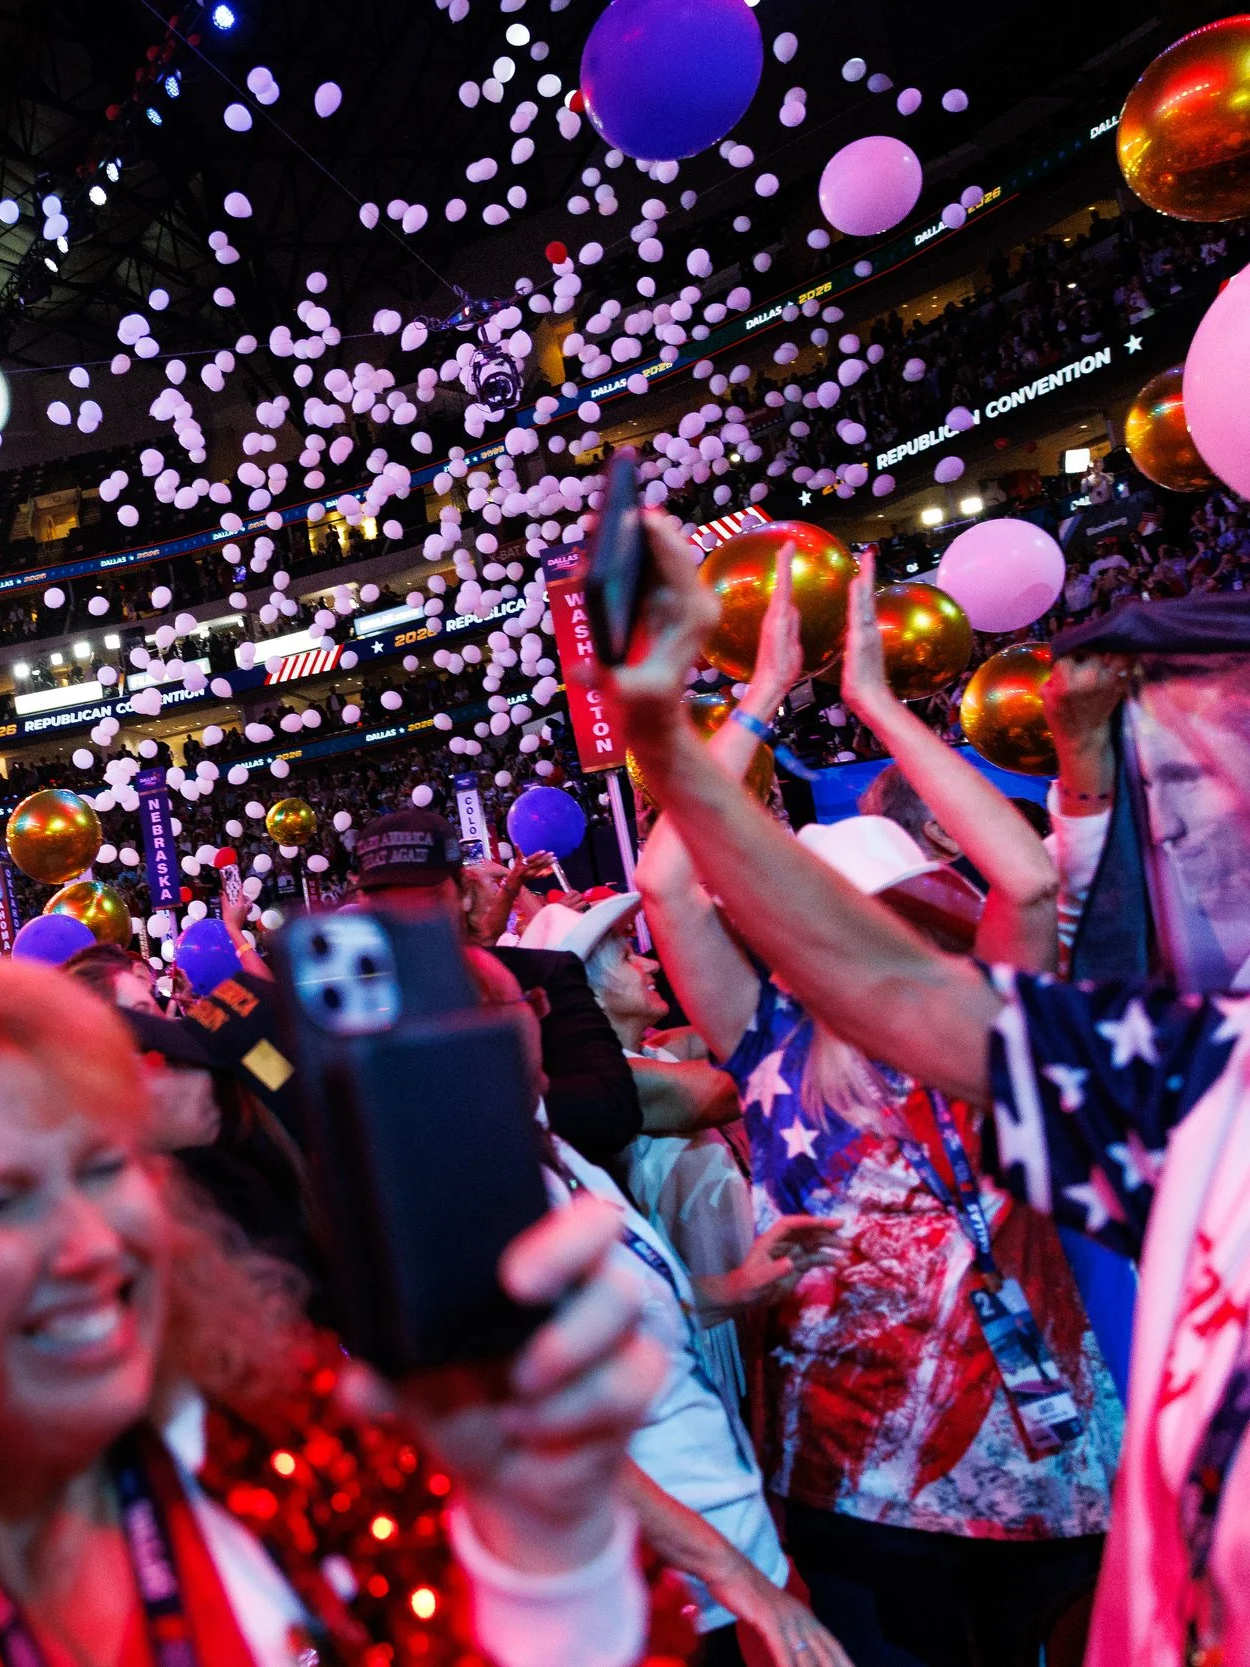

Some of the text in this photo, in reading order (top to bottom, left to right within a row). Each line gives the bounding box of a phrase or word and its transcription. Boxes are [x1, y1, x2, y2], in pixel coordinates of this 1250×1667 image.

[1090, 115, 1120, 139] DALL
[914, 221, 948, 246] DALLA
[745, 281, 833, 330] DALLAS 2026
[590, 378, 628, 398] DALLAS
[876, 347, 1112, 471] REPUBLICN CONVENTION
[100, 556, 127, 567] DALLAS
[547, 553, 580, 566] DALLAS
[563, 591, 614, 753] WASHGTON
[25, 706, 112, 732] REPUBLICAN
[116, 688, 205, 714] CONTION
[506, 693, 528, 705] LLAS
[366, 728, 397, 742] DALLAS
[147, 798, 173, 900] NEBRASKA
